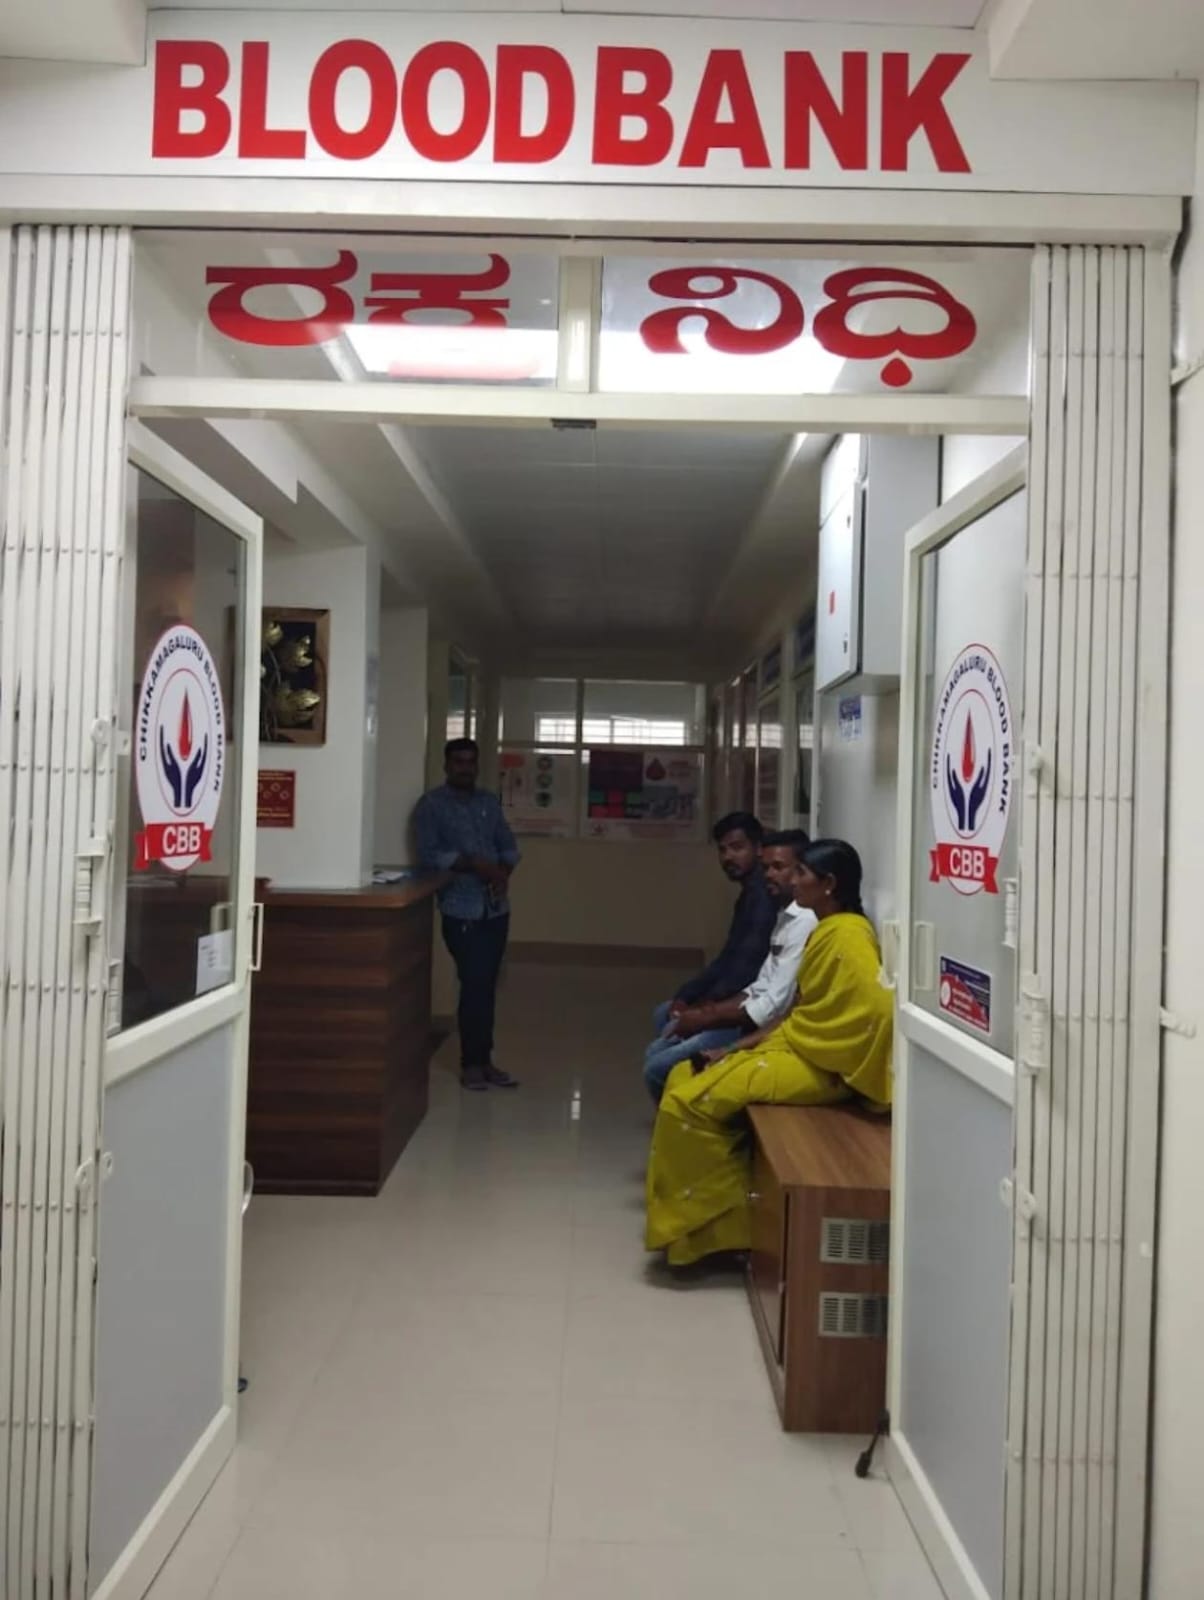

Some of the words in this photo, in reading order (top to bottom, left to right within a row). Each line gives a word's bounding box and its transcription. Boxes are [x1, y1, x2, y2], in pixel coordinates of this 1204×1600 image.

[152, 39, 576, 163] BLOOD
[591, 46, 973, 173] BANK
[639, 266, 977, 387] ನಿಧಿ
[986, 667, 1009, 734] BLOOD
[999, 743, 1010, 815] BANK
[161, 825, 201, 855] CBB
[950, 847, 985, 879] CBB
